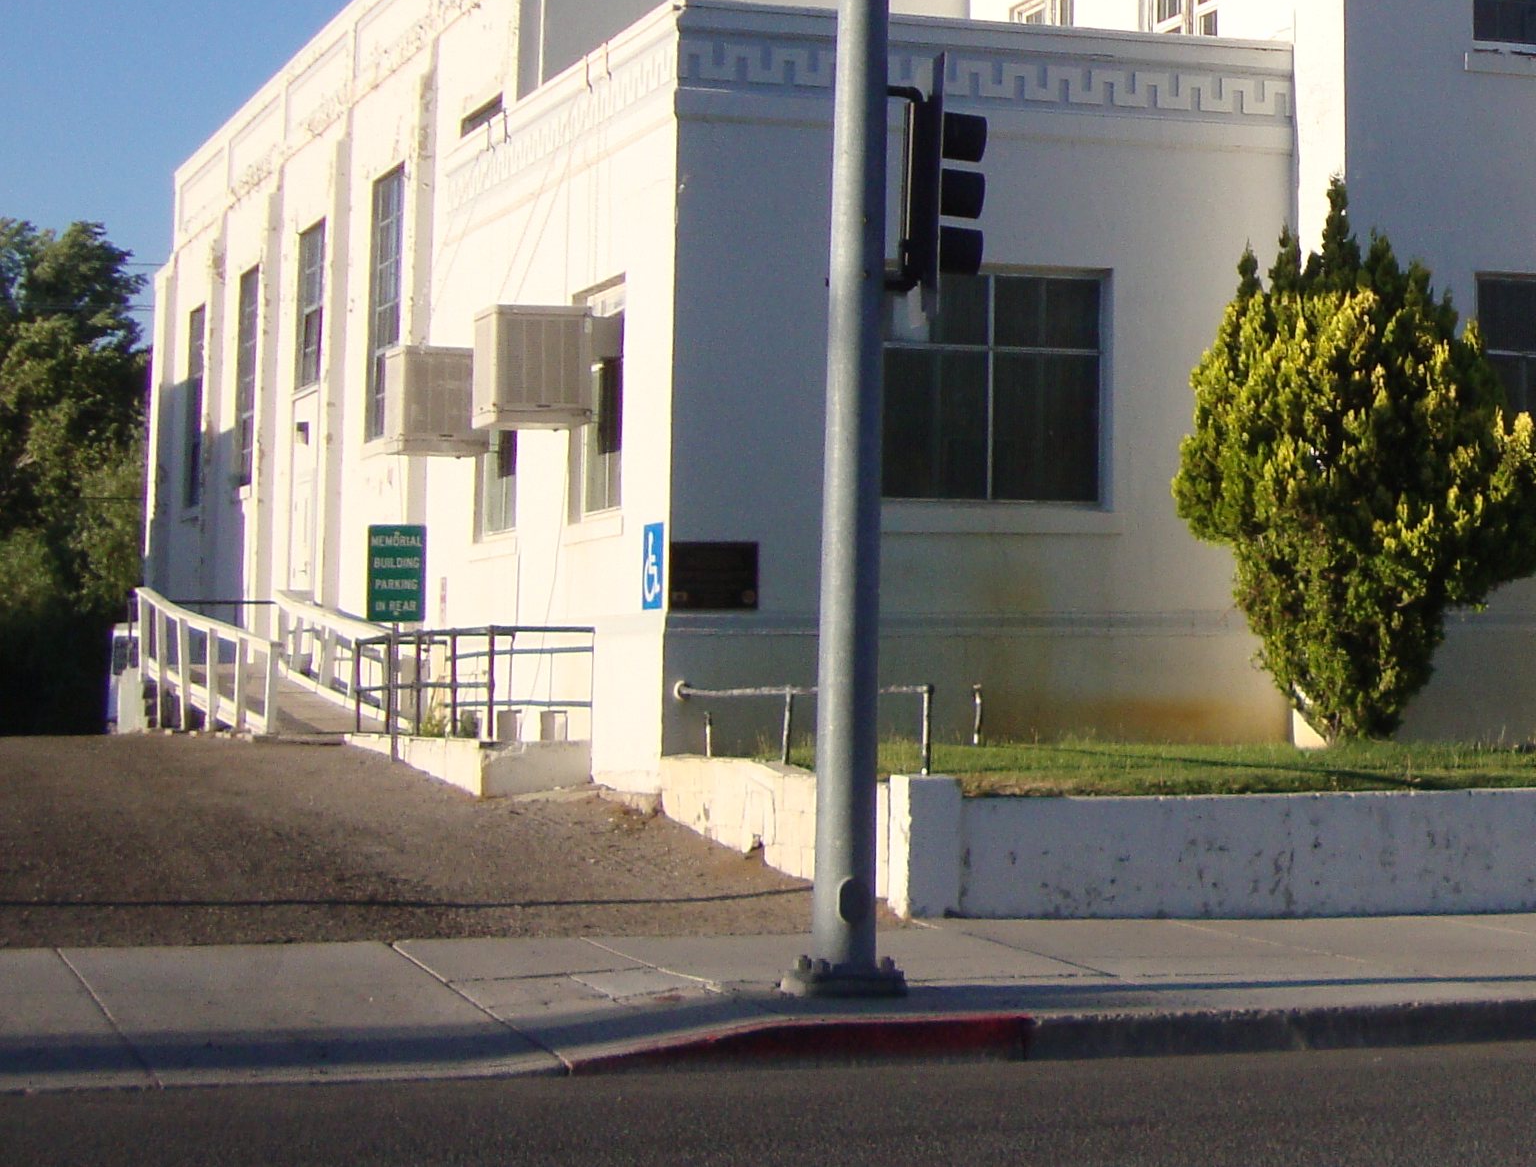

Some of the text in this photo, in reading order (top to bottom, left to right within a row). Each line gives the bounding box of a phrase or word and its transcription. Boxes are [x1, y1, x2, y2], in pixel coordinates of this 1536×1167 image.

[371, 535, 422, 547] MEMORIAL
[373, 557, 420, 568] BUILDING
[374, 578, 418, 590] PARKING
[375, 600, 417, 611] IN REAR
